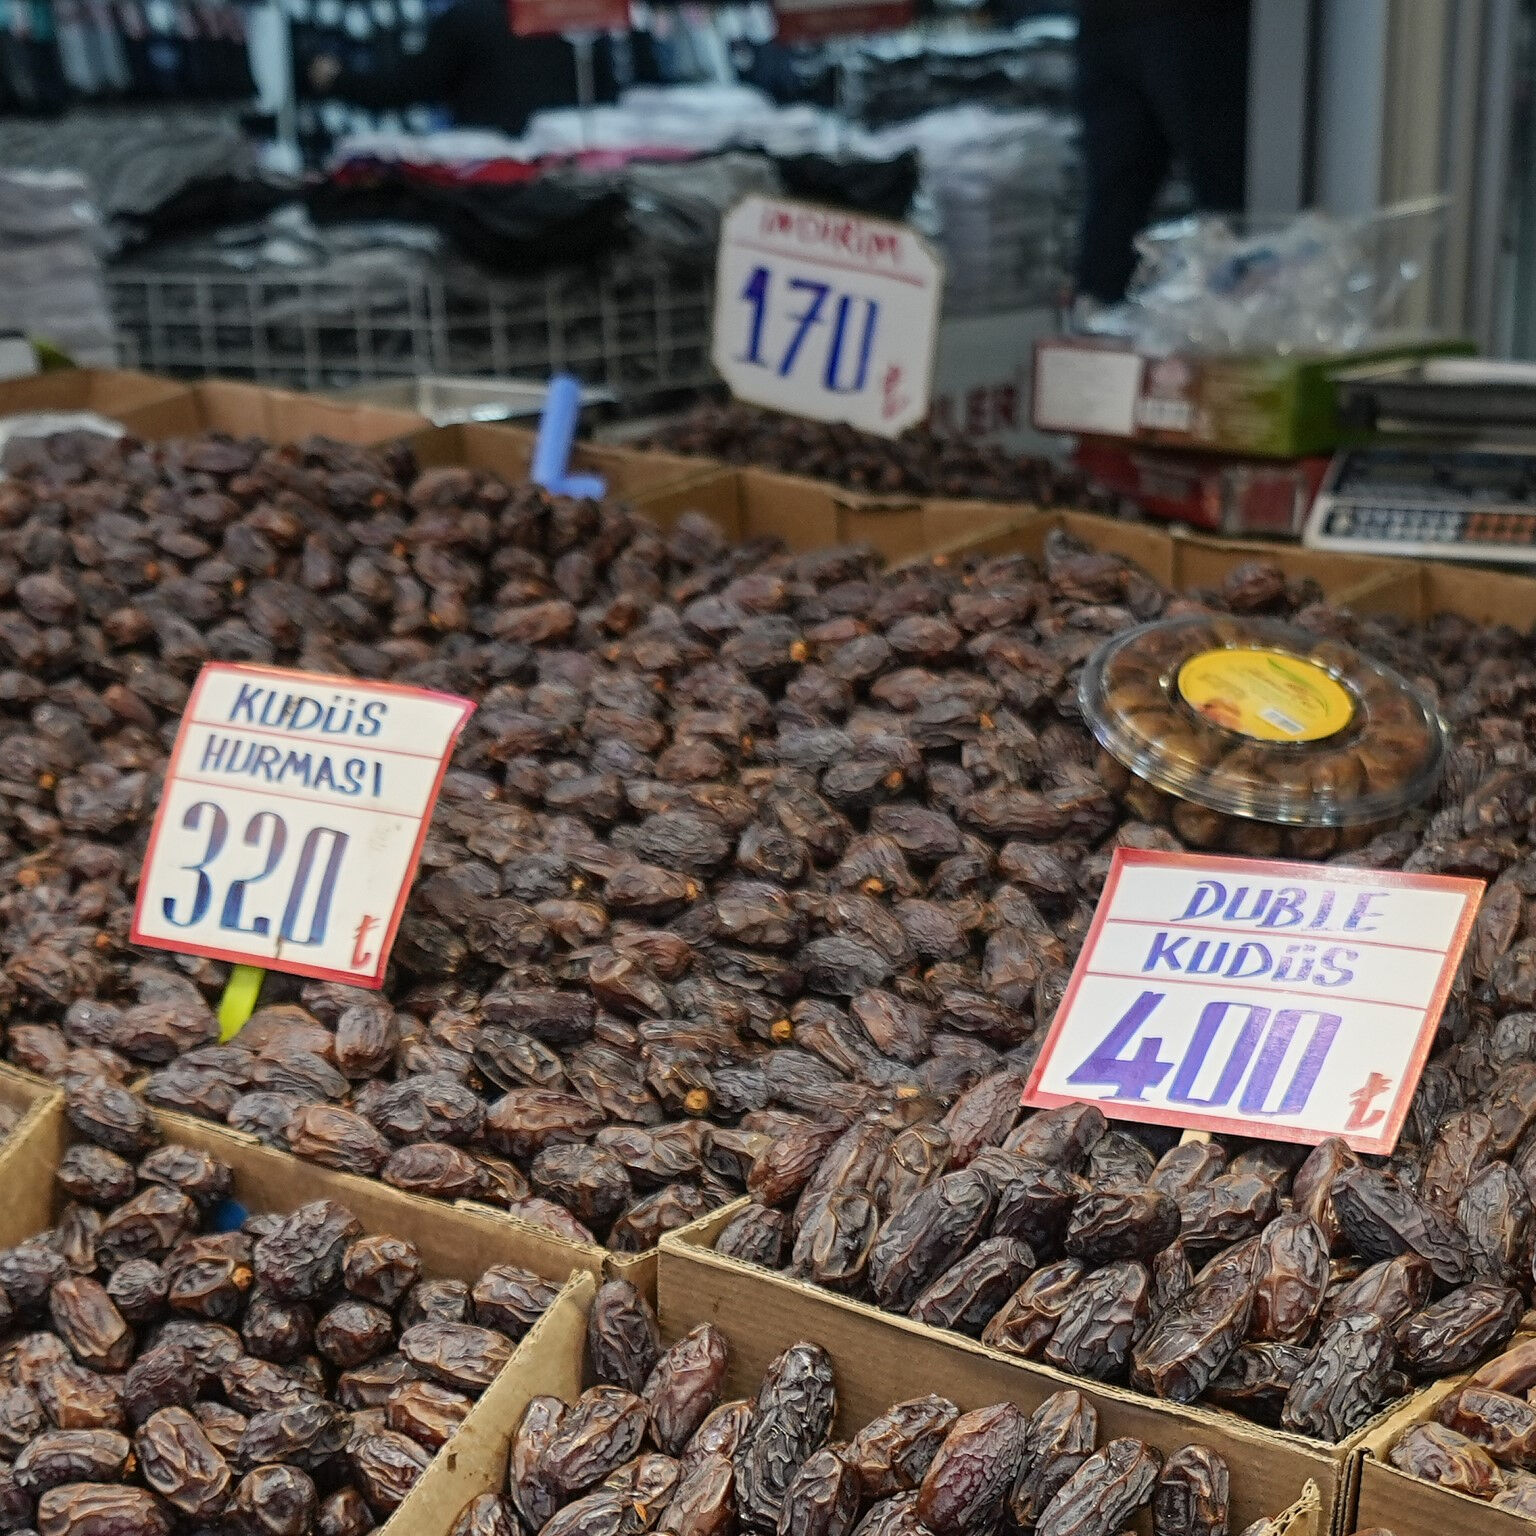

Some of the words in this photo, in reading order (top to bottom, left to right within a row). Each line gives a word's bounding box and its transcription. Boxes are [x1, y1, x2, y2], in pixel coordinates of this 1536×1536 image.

[735, 265, 880, 395] 170
[199, 733, 383, 798] HURMASI
[161, 800, 351, 947] 320
[1169, 879, 1391, 934] DUBLE
[1066, 990, 1343, 1118] 400
